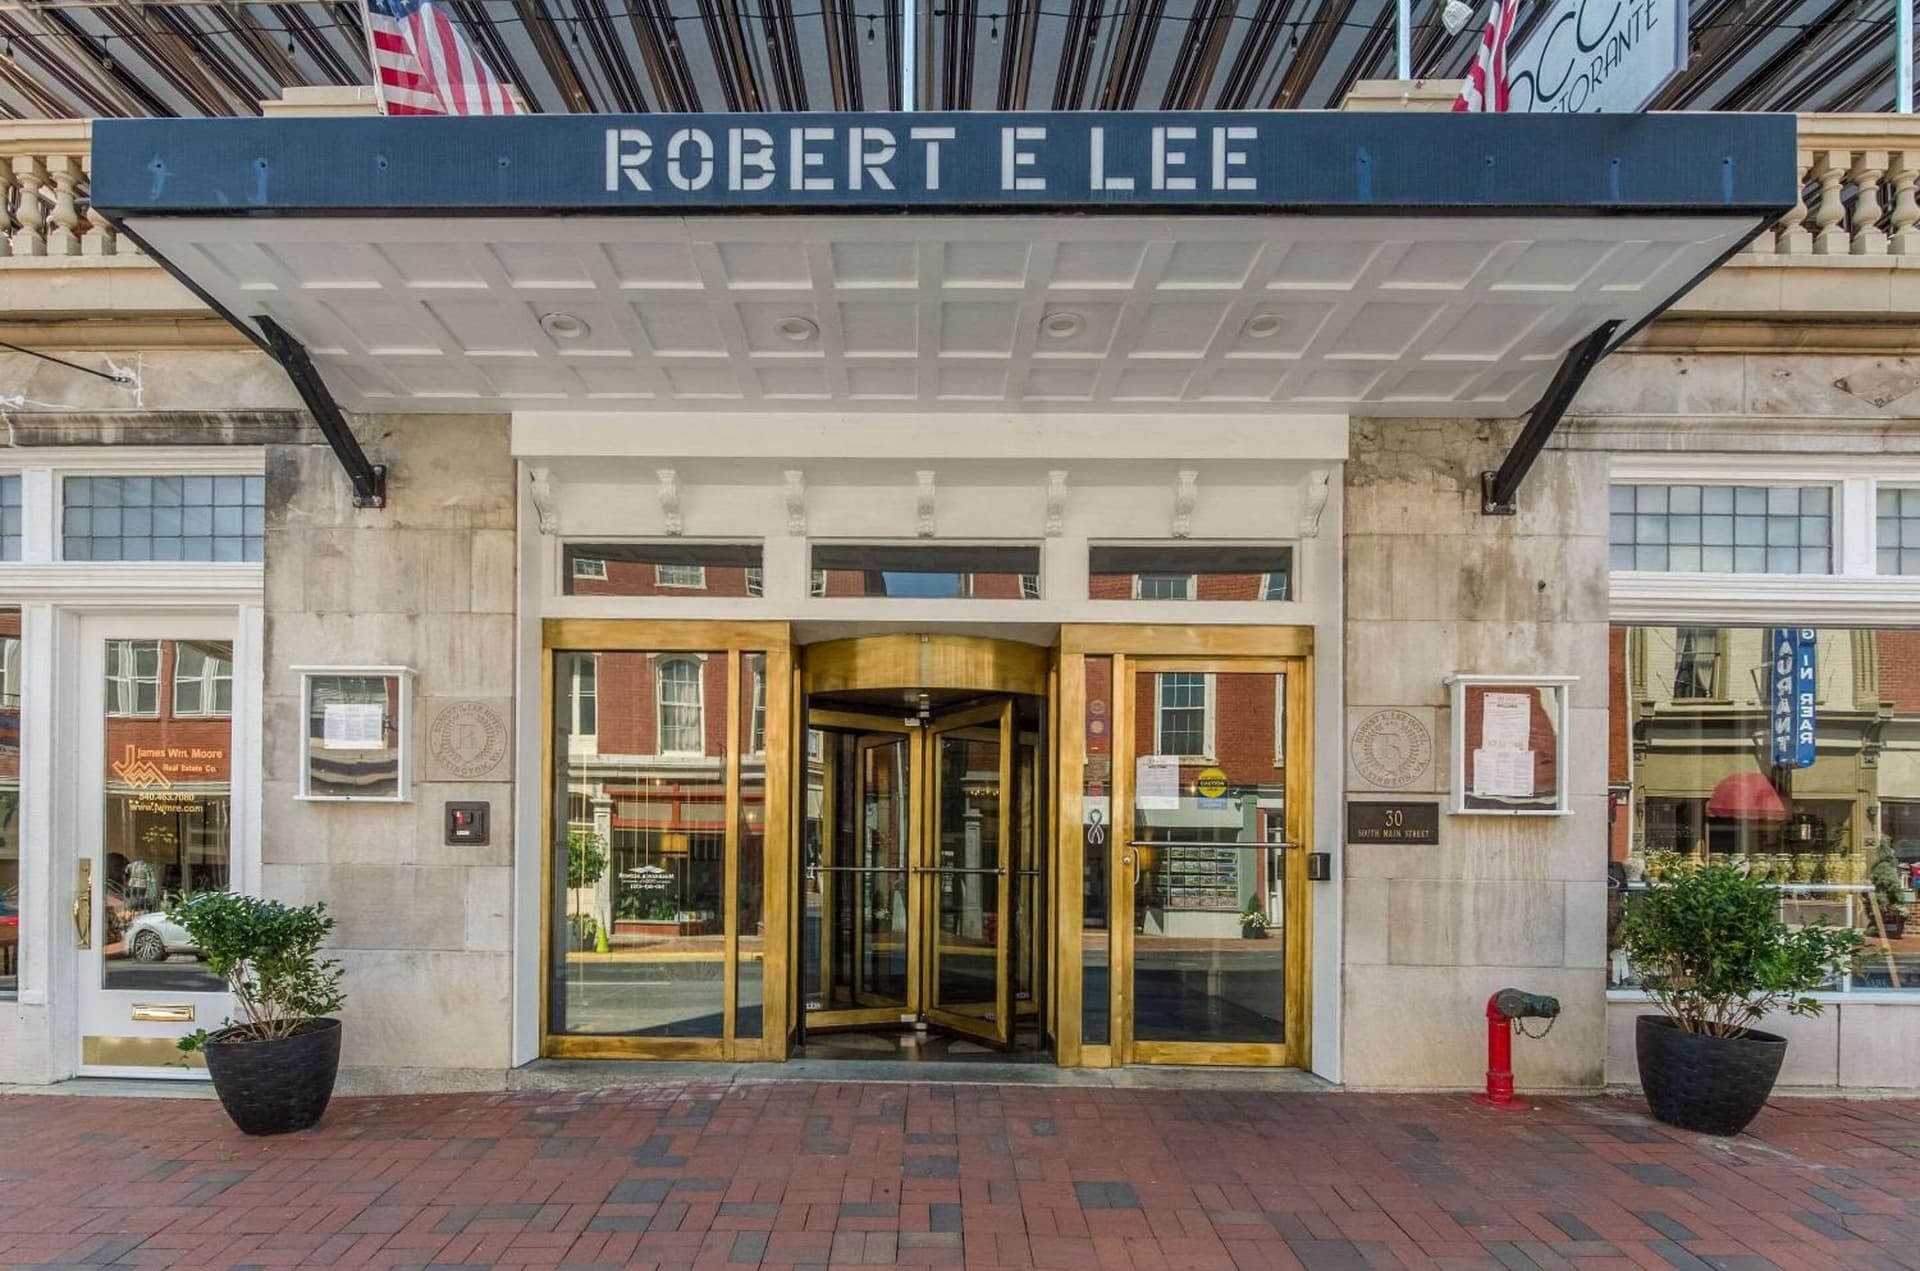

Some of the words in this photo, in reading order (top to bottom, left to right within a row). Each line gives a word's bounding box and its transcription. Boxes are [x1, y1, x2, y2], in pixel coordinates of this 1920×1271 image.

[606, 128, 955, 191] ROBERT
[1002, 127, 1047, 190] E
[1091, 127, 1258, 190] LEE
[137, 748, 166, 759] James
[168, 748, 189, 758] Wm.
[191, 748, 223, 758] Moore
[181, 764, 202, 772] Estate
[1385, 810, 1403, 827] 30
[1358, 829, 1380, 838] SOUTH
[1383, 829, 1401, 838] MAIN
[1405, 829, 1430, 838] STREET
